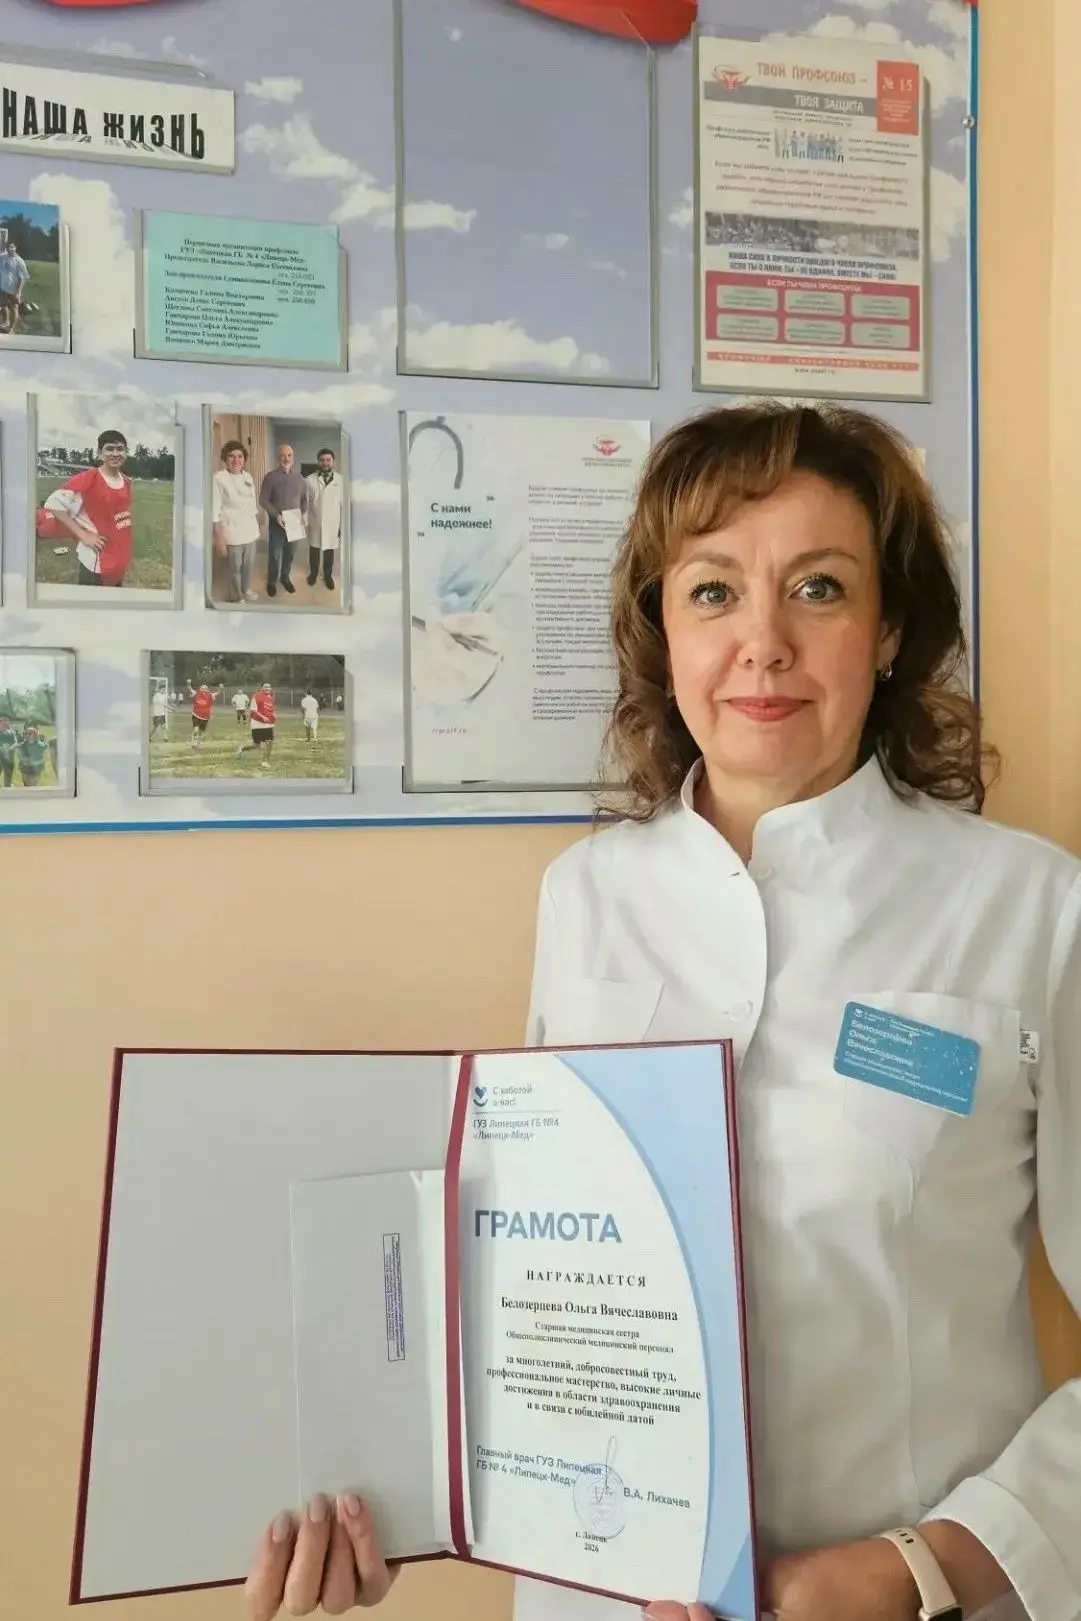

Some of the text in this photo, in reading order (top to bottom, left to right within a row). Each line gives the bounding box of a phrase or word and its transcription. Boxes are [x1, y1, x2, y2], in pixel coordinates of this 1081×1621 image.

[757, 62, 786, 78] ТВОЙ
[792, 66, 856, 85] ПРОФСОЮЗ
[794, 94, 819, 109] ТВОЯ
[824, 97, 864, 113] ЗАЩИТА
[3, 87, 205, 160] НАША ЖИЗНЬ
[430, 502, 471, 514] С нами
[431, 518, 492, 530] надежнее!
[493, 1085, 532, 1095] С заботой
[473, 1119, 487, 1129] ГУЗ
[489, 1119, 529, 1129] Липецкая
[532, 1118, 541, 1127] ГБ
[474, 1209, 623, 1244] ГРАМОТА
[526, 1269, 648, 1288] НАГРАЖДАЕТСЯ
[501, 1296, 678, 1321] Белозерцева Ольга Вячеславовна
[535, 1320, 640, 1339] Старшая медицинская сестра
[588, 1338, 640, 1350] медицинский
[640, 1344, 674, 1354] персонал
[505, 1355, 677, 1383] за многолетний, добросовестный труд,
[486, 1367, 701, 1399] профессиональное мастерство, высокие личные
[504, 1384, 681, 1414] достижения в области здравоохранения
[527, 1402, 532, 1410] и
[568, 1407, 573, 1415] с
[574, 1407, 625, 1422] юбилейной
[627, 1413, 655, 1425] датой
[476, 1445, 601, 1476] Главный врач ГУЗ Липецкая
[476, 1459, 577, 1487] ГБ № 4 «Липецк-Мед»
[623, 1487, 690, 1508] В.А. Лихачев
[582, 1531, 608, 1543] Липецк
